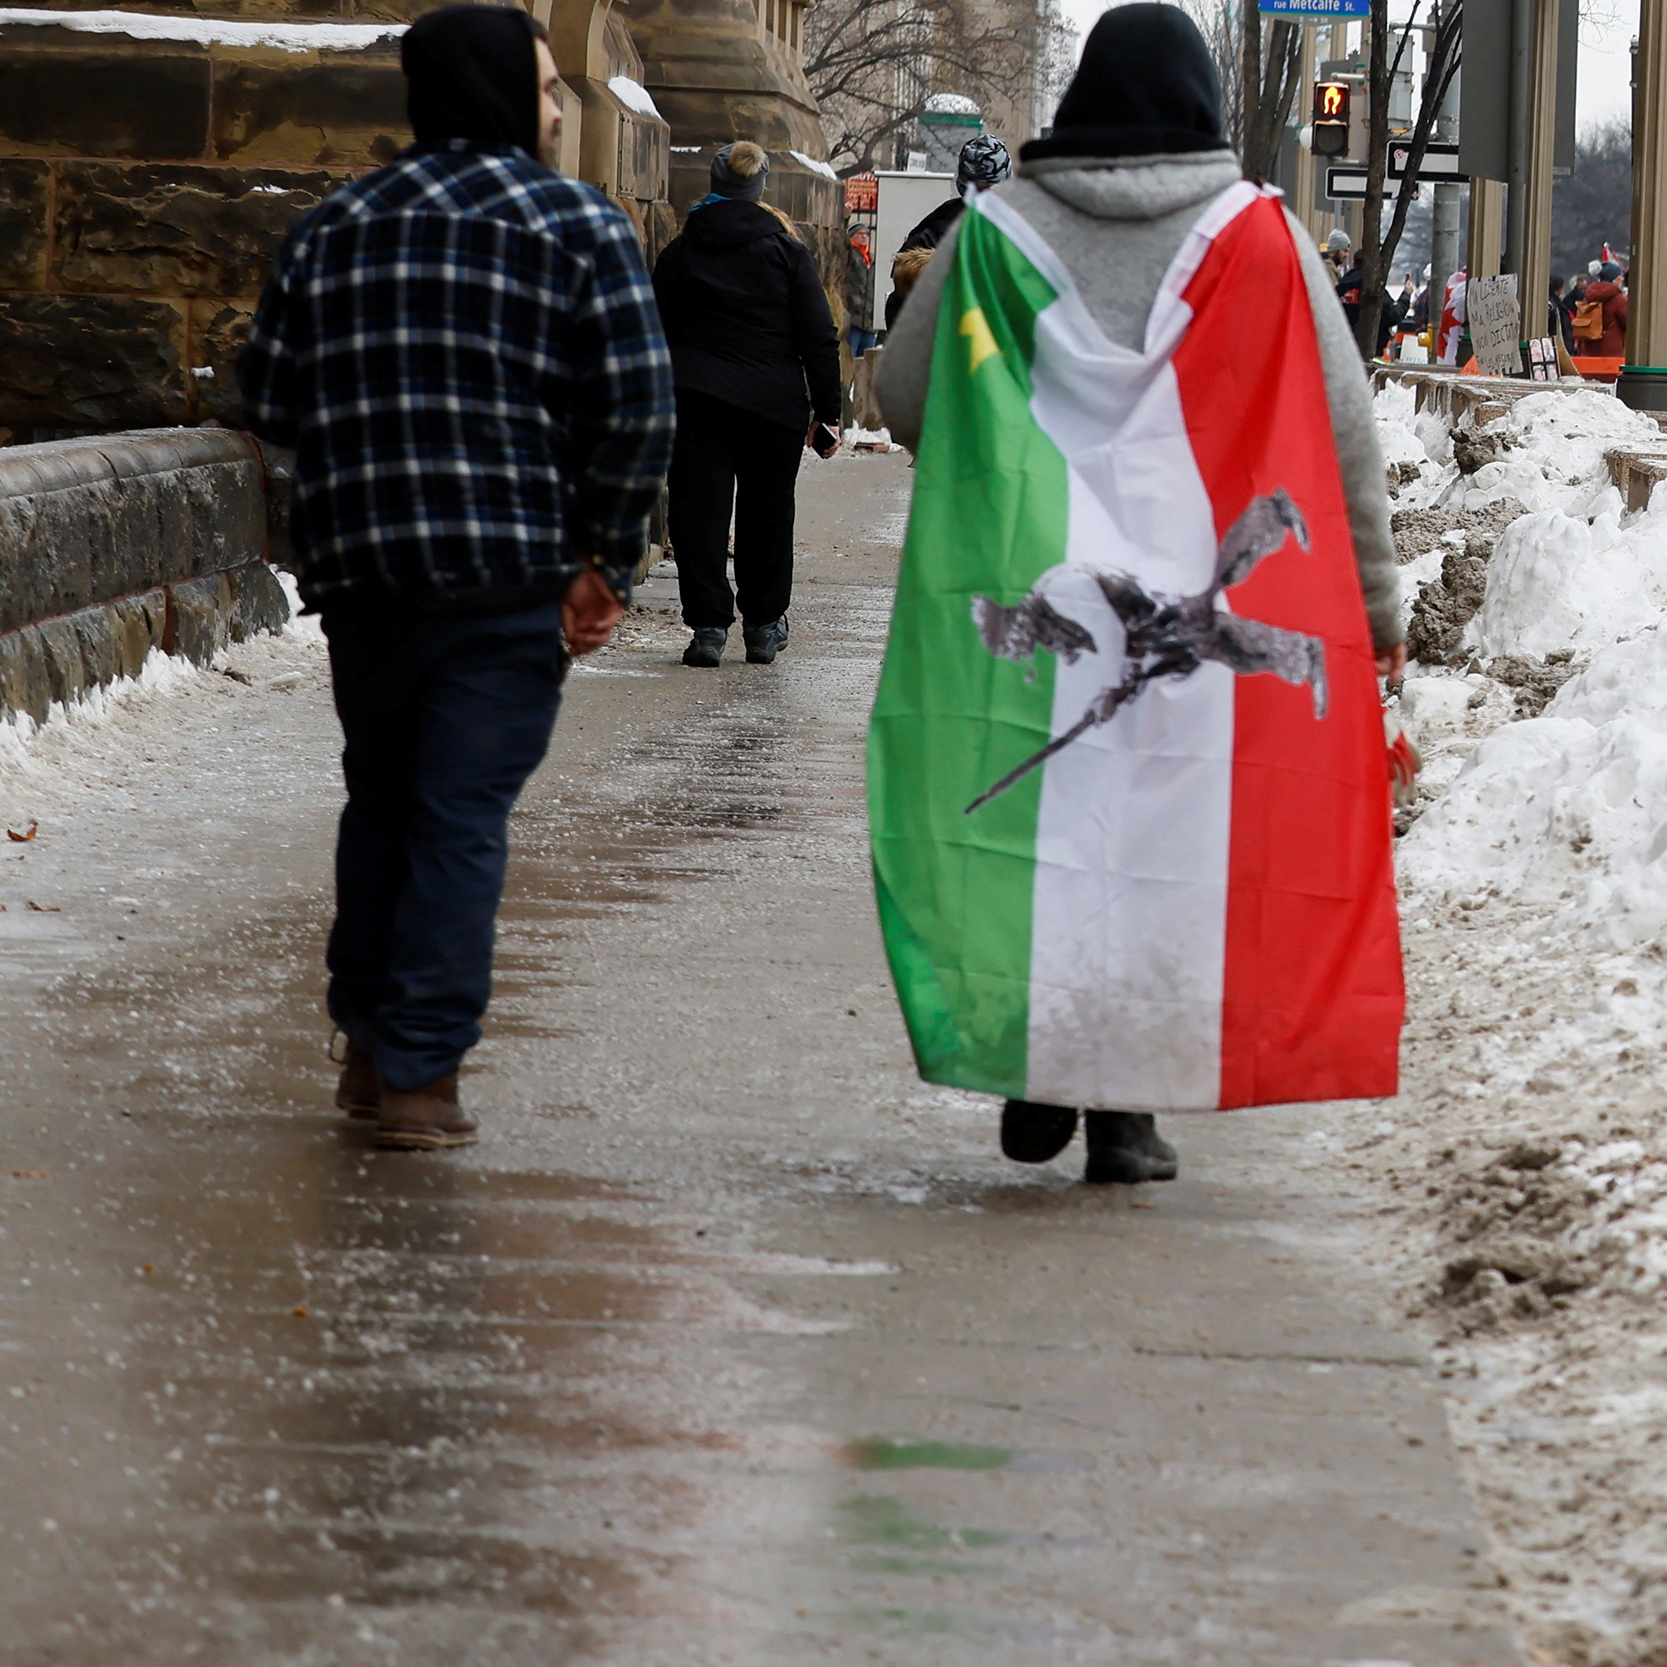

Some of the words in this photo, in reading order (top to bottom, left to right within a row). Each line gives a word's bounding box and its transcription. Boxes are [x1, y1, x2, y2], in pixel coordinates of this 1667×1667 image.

[1273, 0, 1286, 9] rue
[1344, 1, 1355, 12] St.
[1471, 311, 1485, 327] MA
